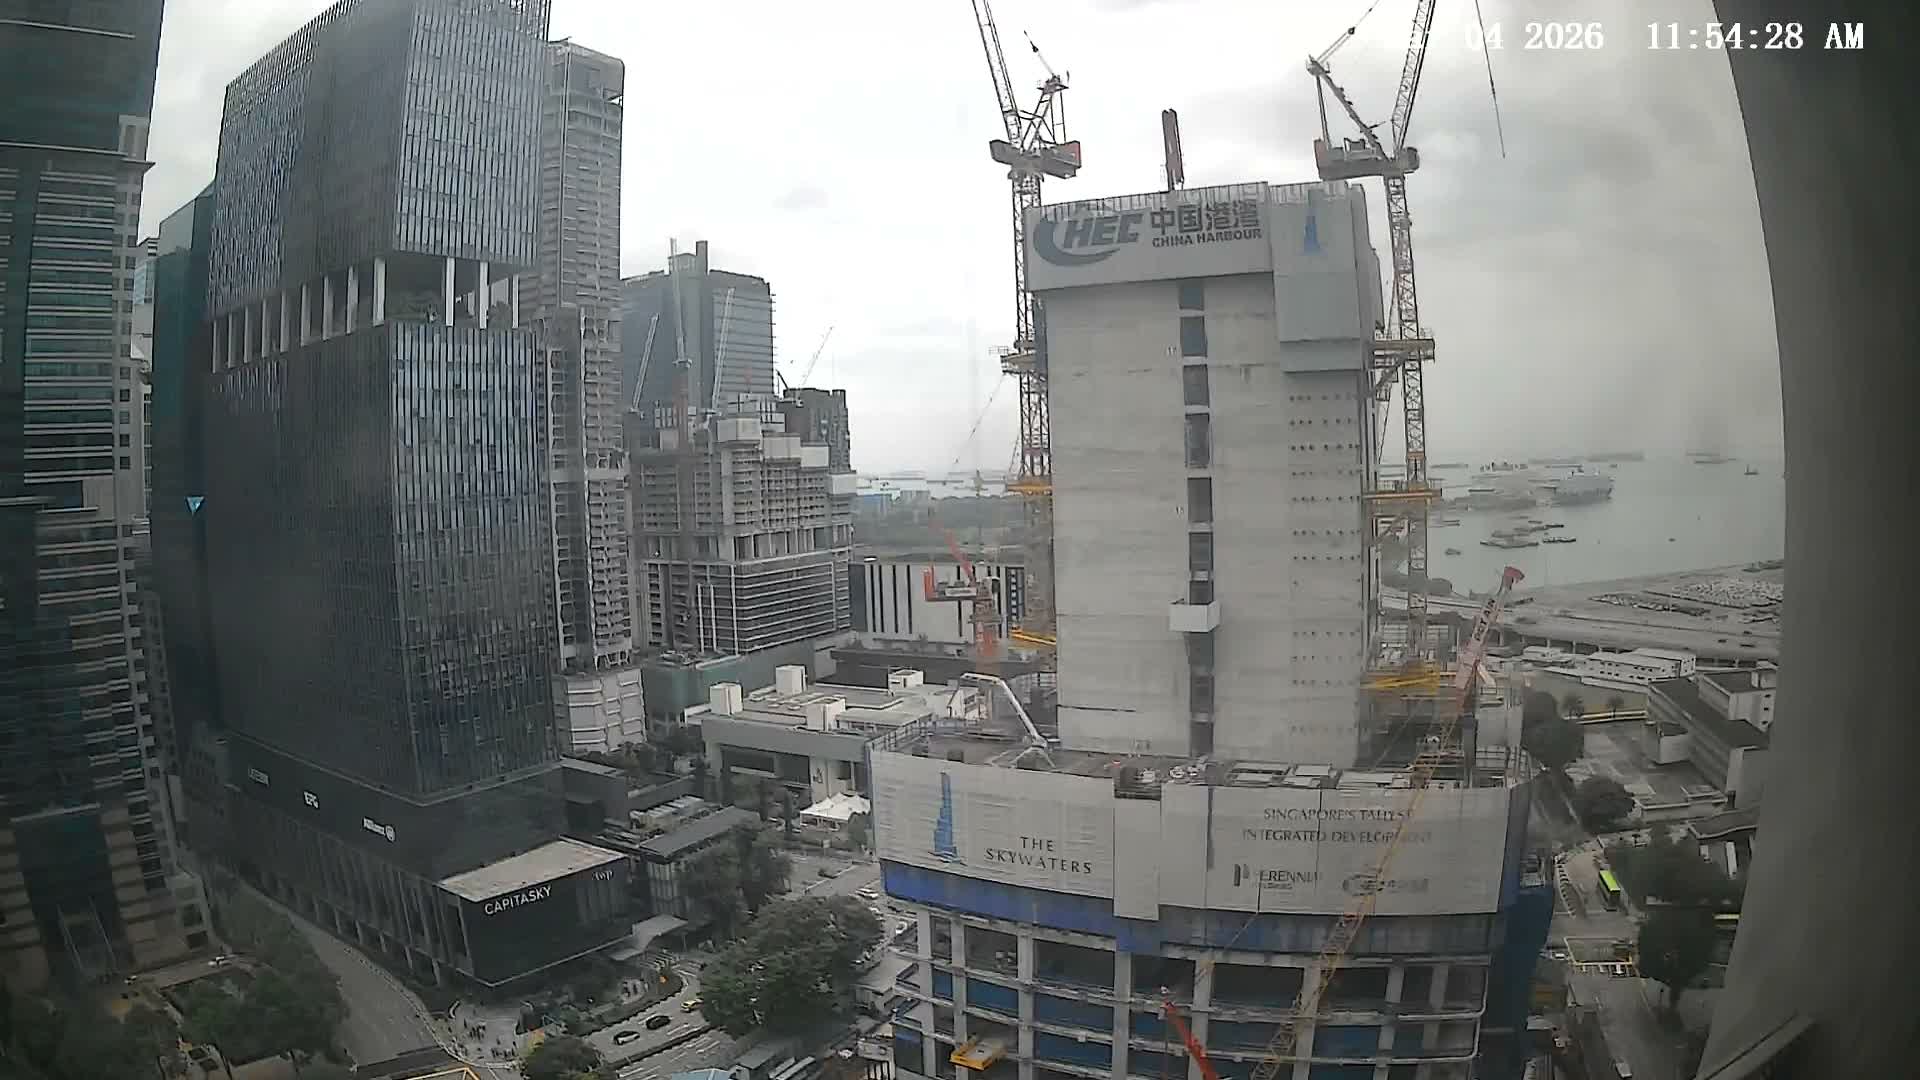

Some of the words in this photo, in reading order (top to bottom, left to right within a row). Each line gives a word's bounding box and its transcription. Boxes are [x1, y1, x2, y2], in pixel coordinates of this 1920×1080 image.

[1151, 200, 1260, 236] 中国港湾
[1152, 233, 1194, 249] CHINA
[1196, 227, 1263, 245] HARBOUR
[1020, 836, 1055, 852] THE
[1242, 828, 1327, 842] INTEGRATED
[984, 848, 1094, 875] SKYWATERS
[483, 885, 553, 916] CAPITASKY
